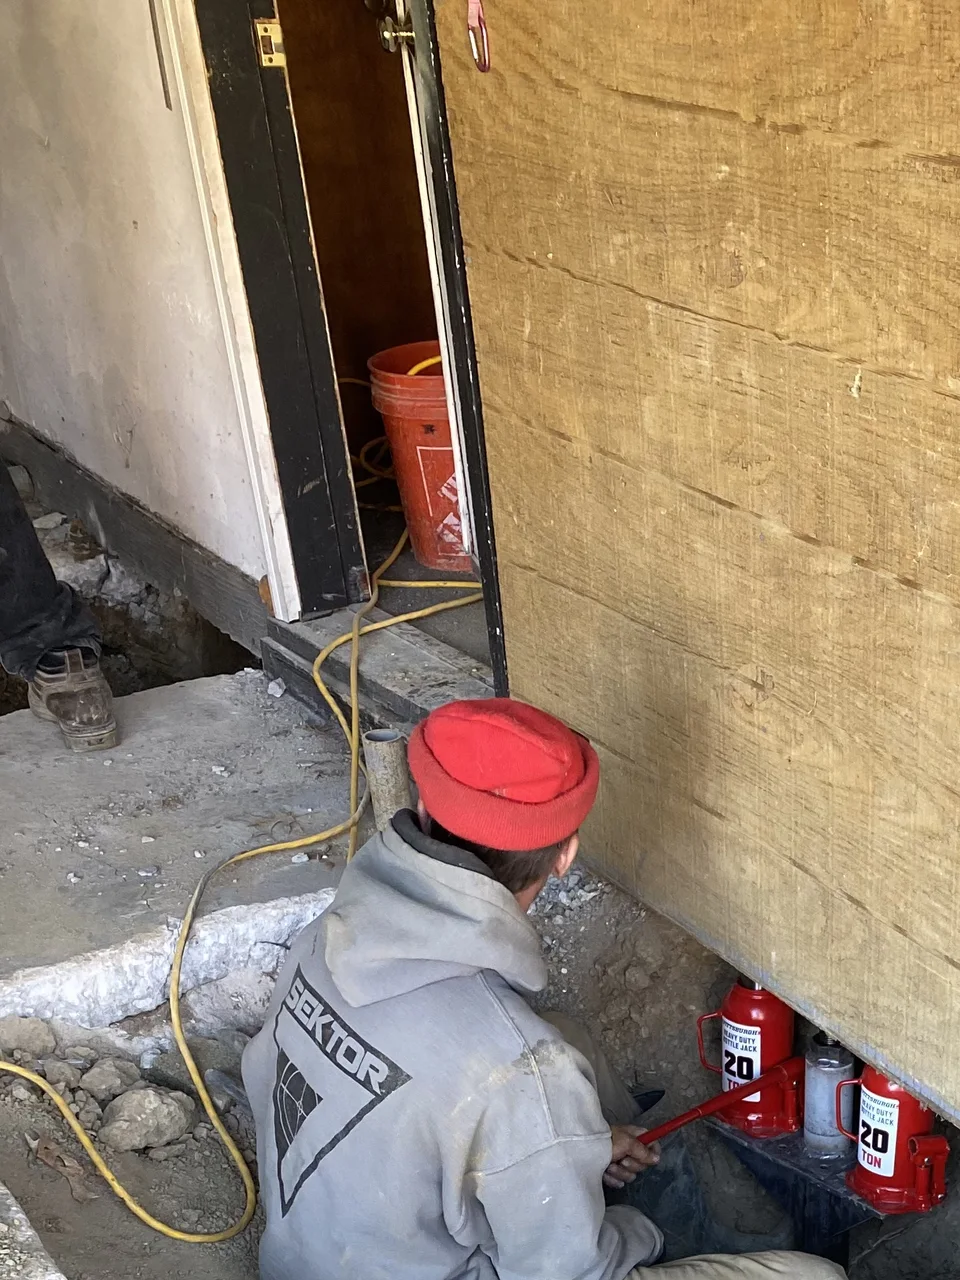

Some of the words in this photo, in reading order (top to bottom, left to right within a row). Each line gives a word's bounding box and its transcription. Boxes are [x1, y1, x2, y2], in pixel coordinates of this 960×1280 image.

[285, 977, 388, 1096] SEKTOR
[739, 1036, 756, 1045] DUTY
[740, 1045, 758, 1053] JACK
[724, 1049, 754, 1080] 20
[876, 1108, 894, 1118] DUTY
[877, 1117, 894, 1126] JACK
[860, 1119, 890, 1154] 20
[861, 1148, 882, 1169] TON
